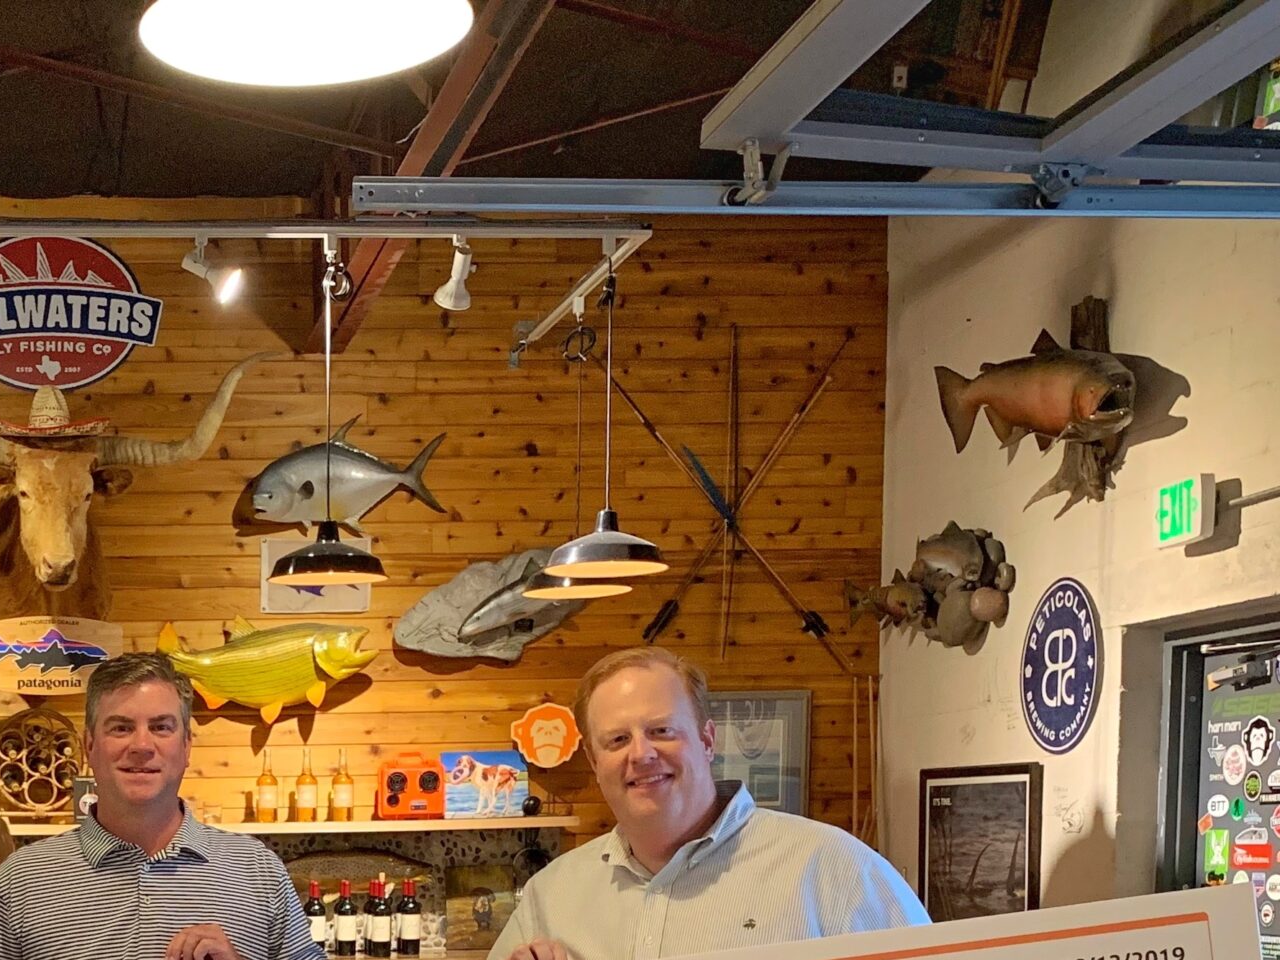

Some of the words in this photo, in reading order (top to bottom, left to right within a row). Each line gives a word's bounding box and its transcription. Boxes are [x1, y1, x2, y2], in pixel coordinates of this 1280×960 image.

[20, 341, 86, 353] FISHING
[1159, 479, 1194, 541] EXIT
[1029, 591, 1092, 651] PETICOLAS
[17, 678, 81, 690] patagonia
[1026, 690, 1056, 741] BREWING
[1059, 682, 1091, 741] COMPANY
[1210, 800, 1227, 812] BTT
